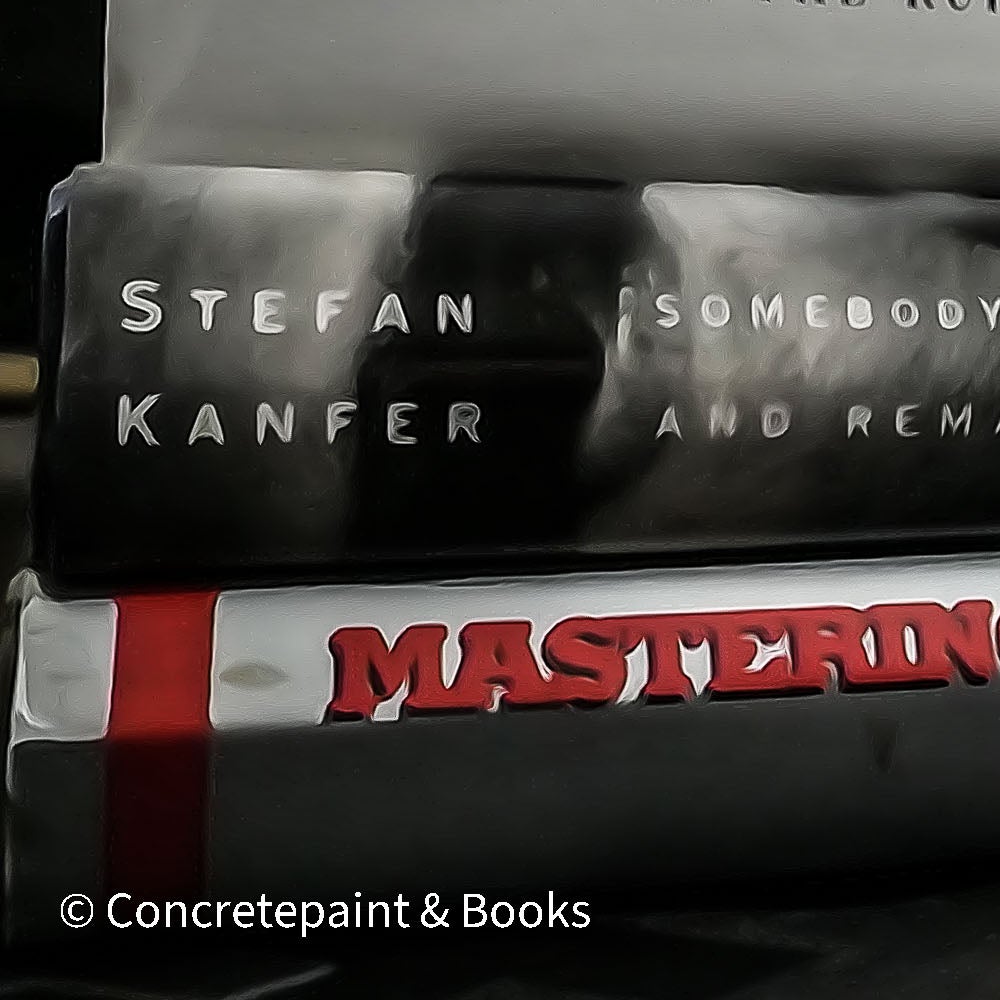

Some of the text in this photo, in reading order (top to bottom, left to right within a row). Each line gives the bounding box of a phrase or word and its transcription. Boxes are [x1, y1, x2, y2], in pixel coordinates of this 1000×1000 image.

[120, 279, 475, 335] STEFAN
[116, 392, 484, 447] KANFER
[655, 402, 793, 441] AND
